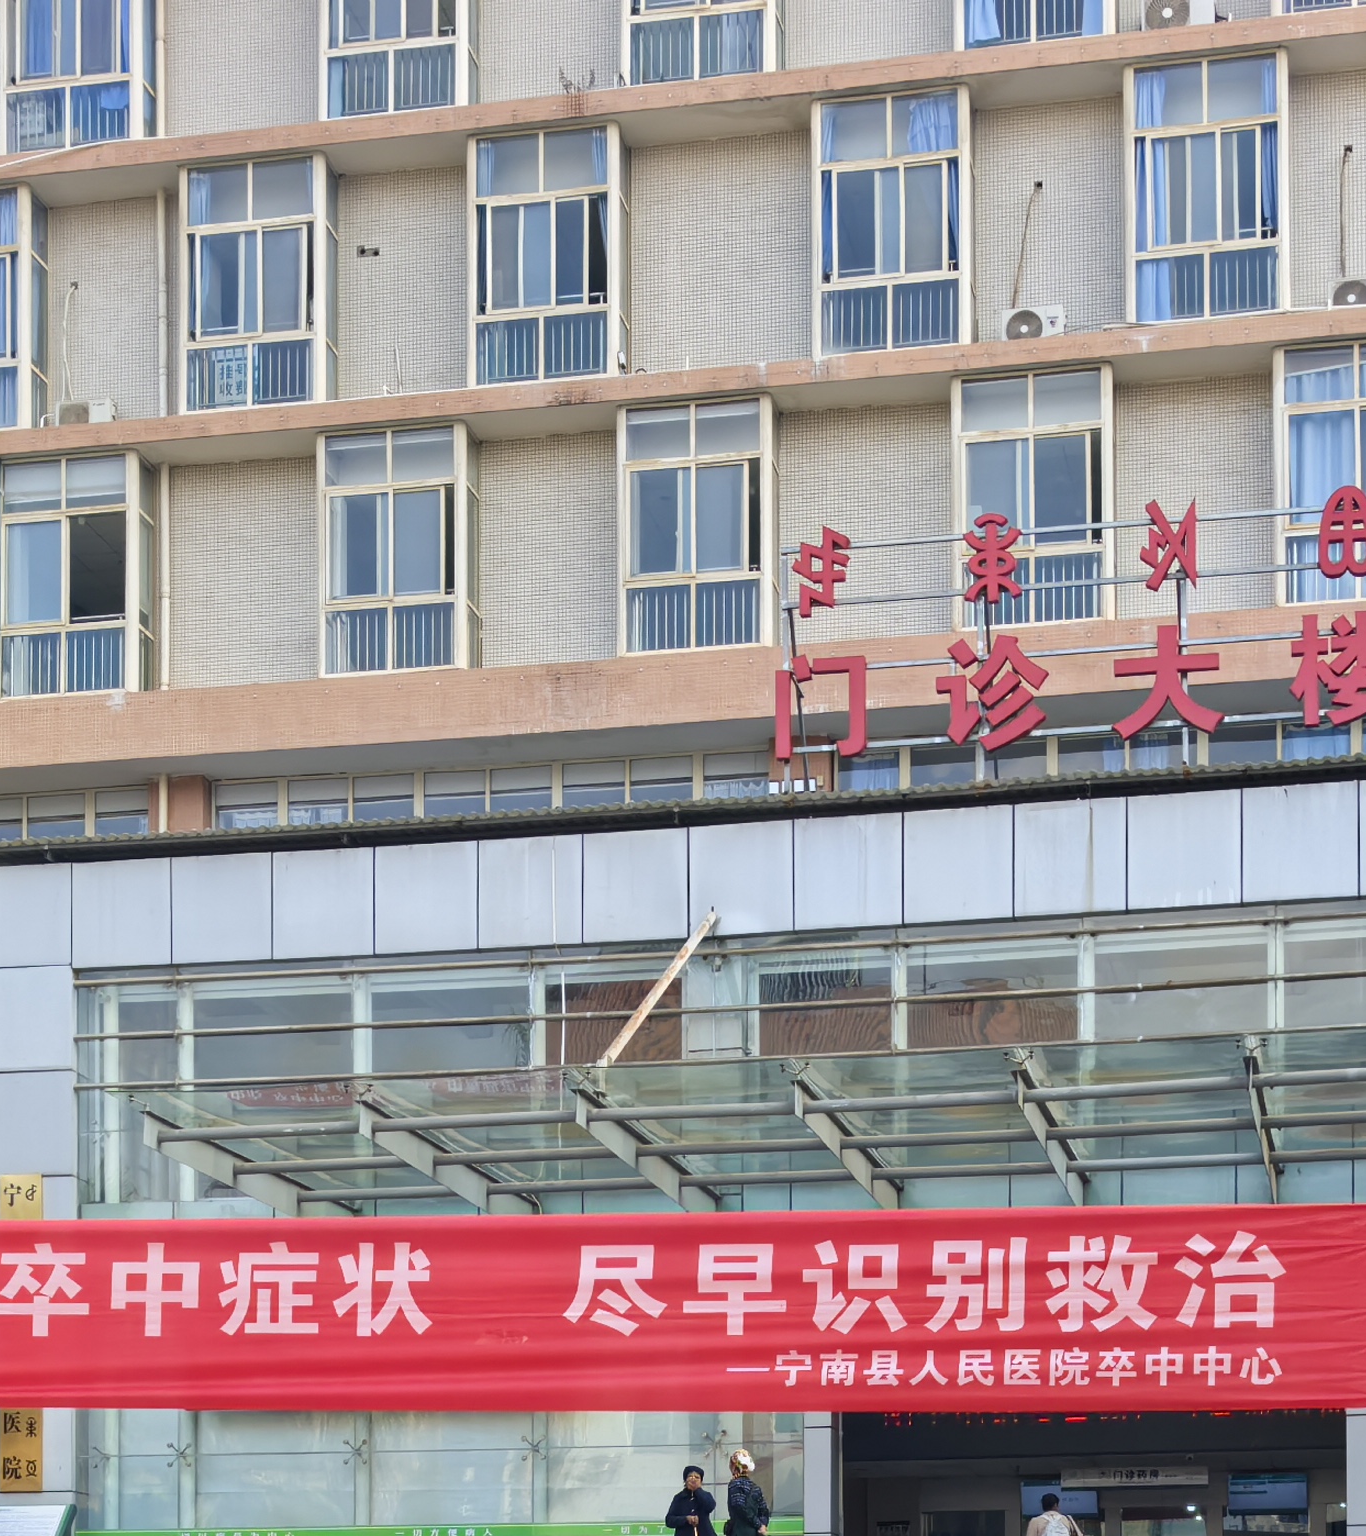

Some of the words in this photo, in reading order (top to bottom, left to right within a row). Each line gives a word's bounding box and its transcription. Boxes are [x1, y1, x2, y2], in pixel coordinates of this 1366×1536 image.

[3, 1184, 22, 1207] 宁
[561, 1229, 1288, 1337] 尽早识别救治
[2, 1411, 22, 1481] 医院
